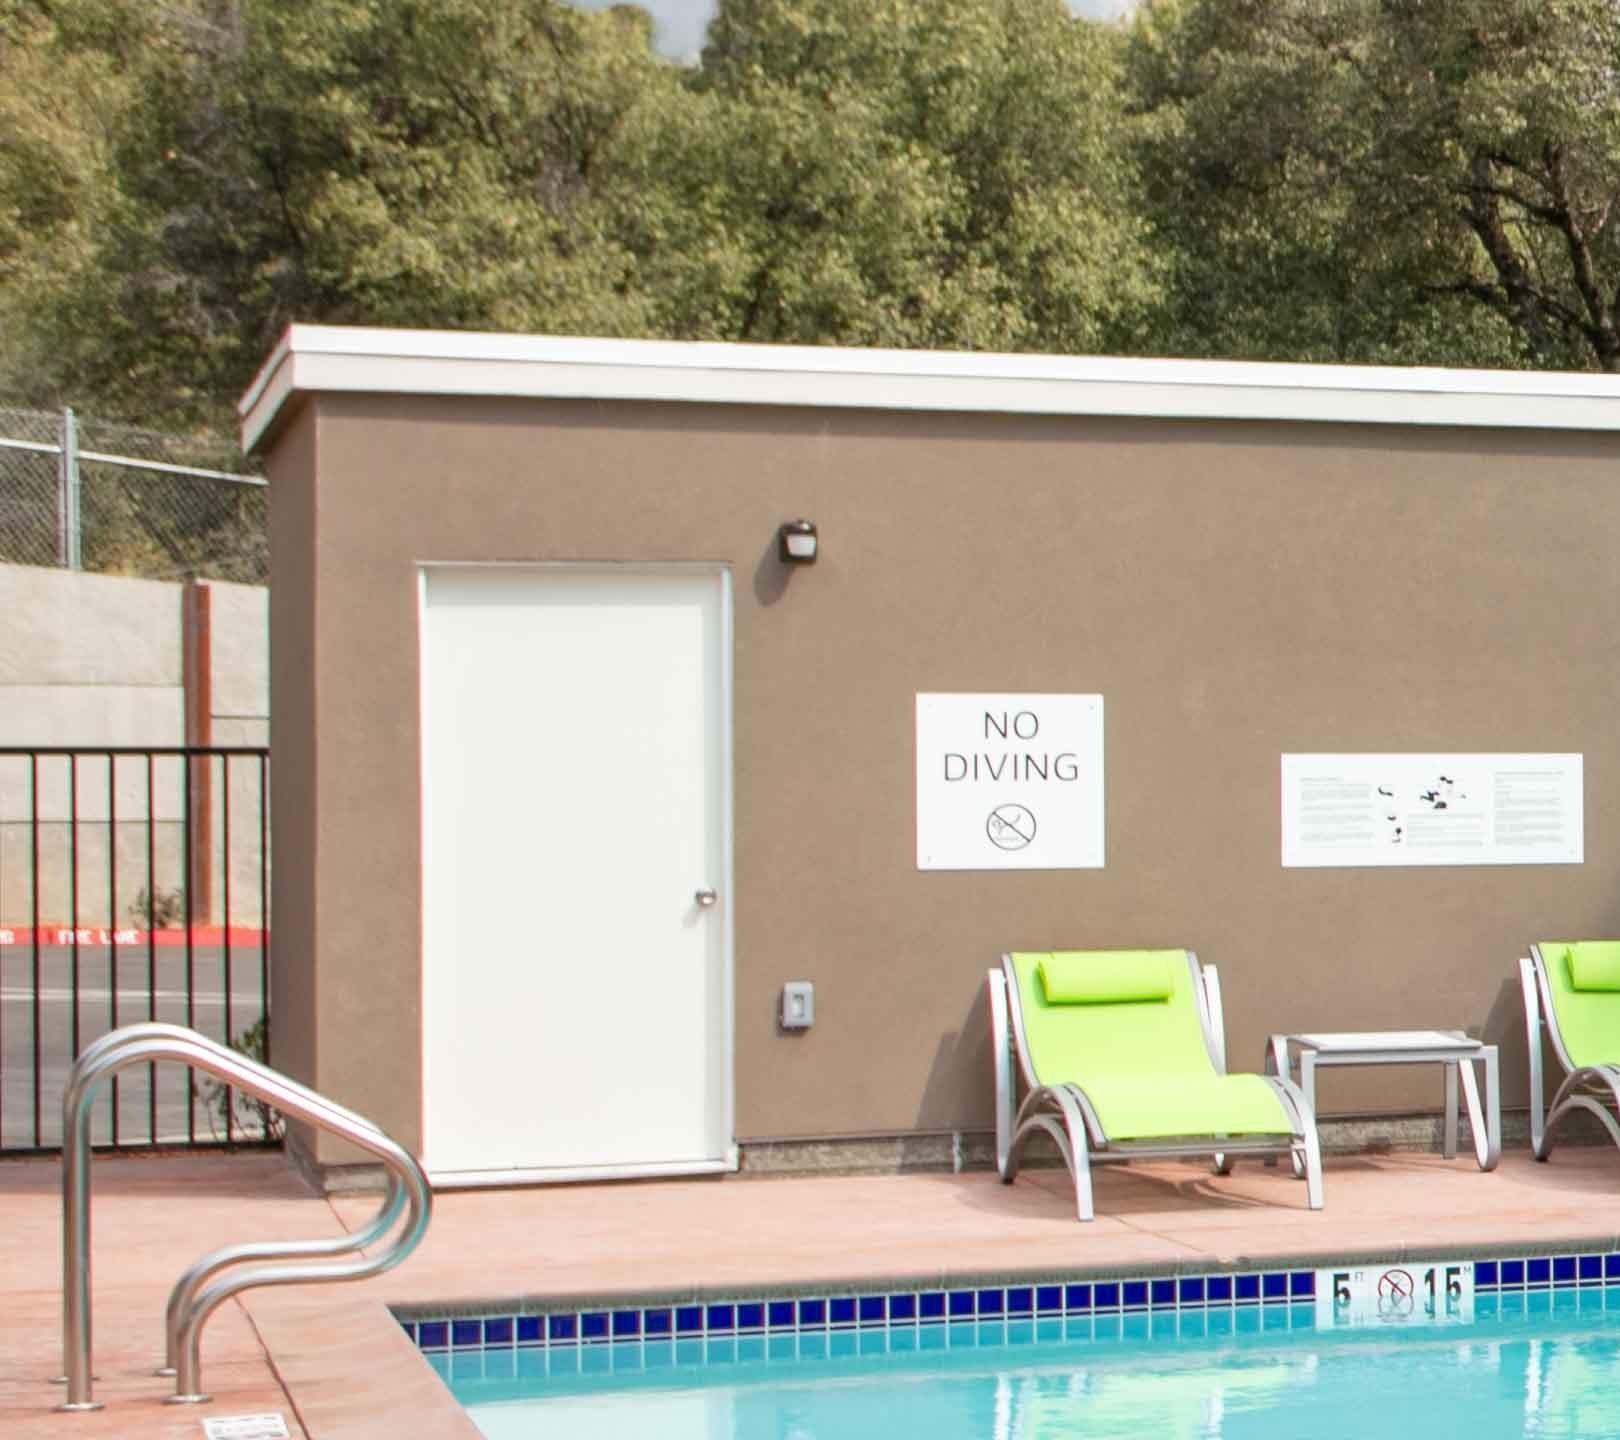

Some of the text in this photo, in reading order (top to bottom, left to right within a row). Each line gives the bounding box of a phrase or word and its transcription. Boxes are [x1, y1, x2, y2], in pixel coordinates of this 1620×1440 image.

[984, 710, 1040, 740] NO
[943, 752, 1079, 782] DIVING
[1333, 1272, 1352, 1308] 5
